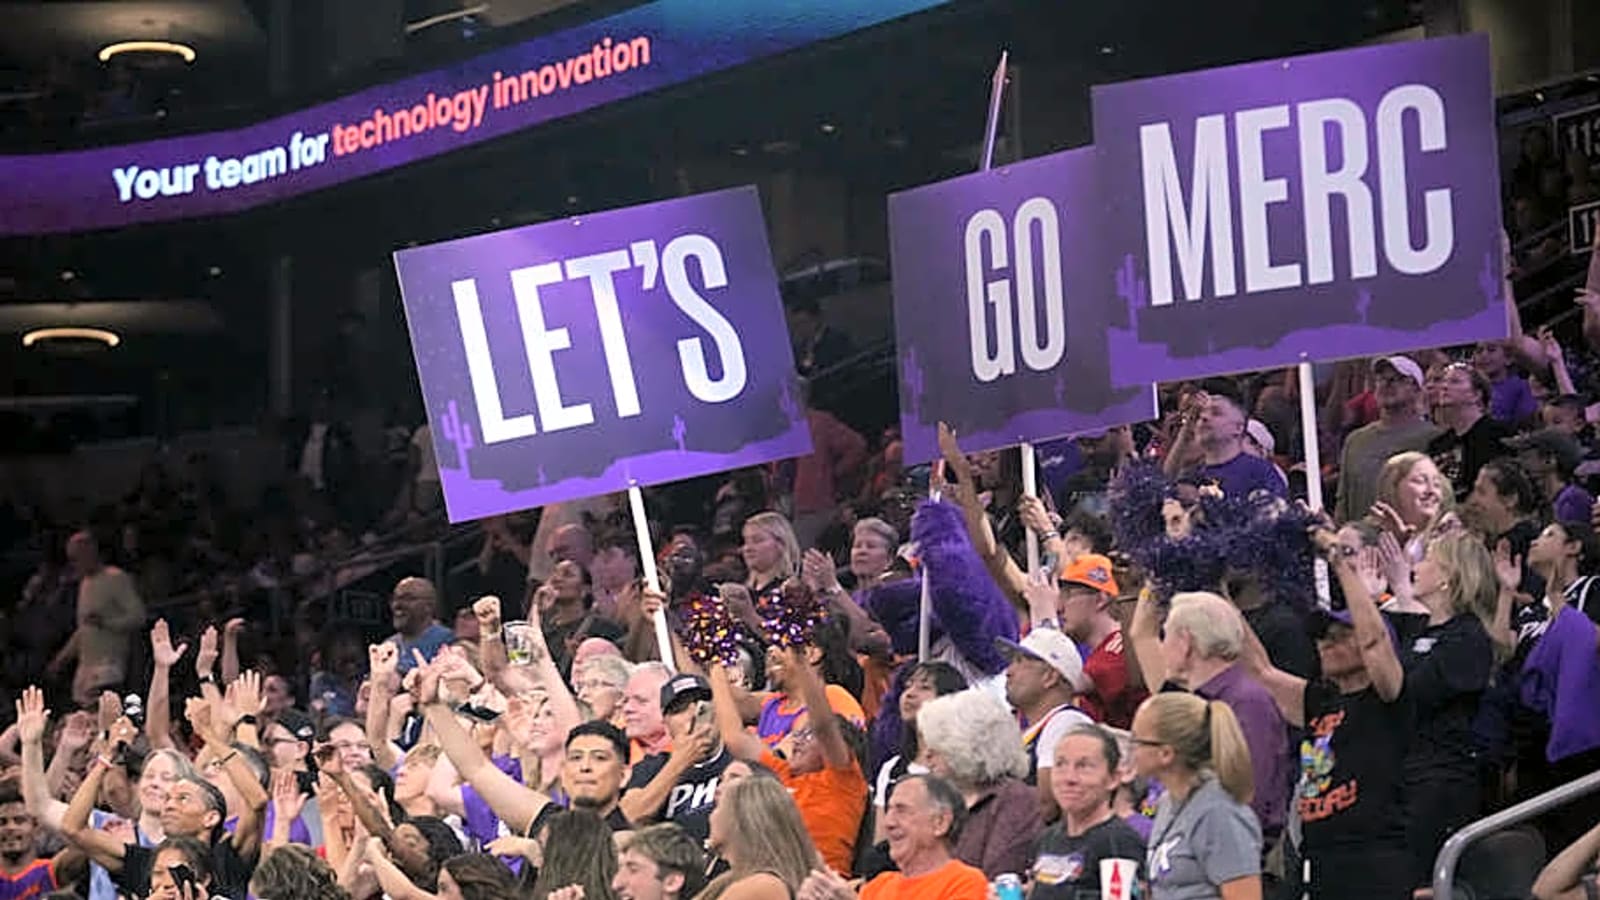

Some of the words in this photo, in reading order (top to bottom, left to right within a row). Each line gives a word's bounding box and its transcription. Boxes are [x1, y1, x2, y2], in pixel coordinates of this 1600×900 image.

[112, 165, 199, 202] Your
[204, 146, 287, 190] team
[289, 131, 329, 171] for
[332, 84, 489, 156] technology
[492, 36, 650, 109] innovation
[1138, 84, 1454, 306] MERC
[450, 233, 748, 445] LET'S
[964, 196, 1067, 383] GO
